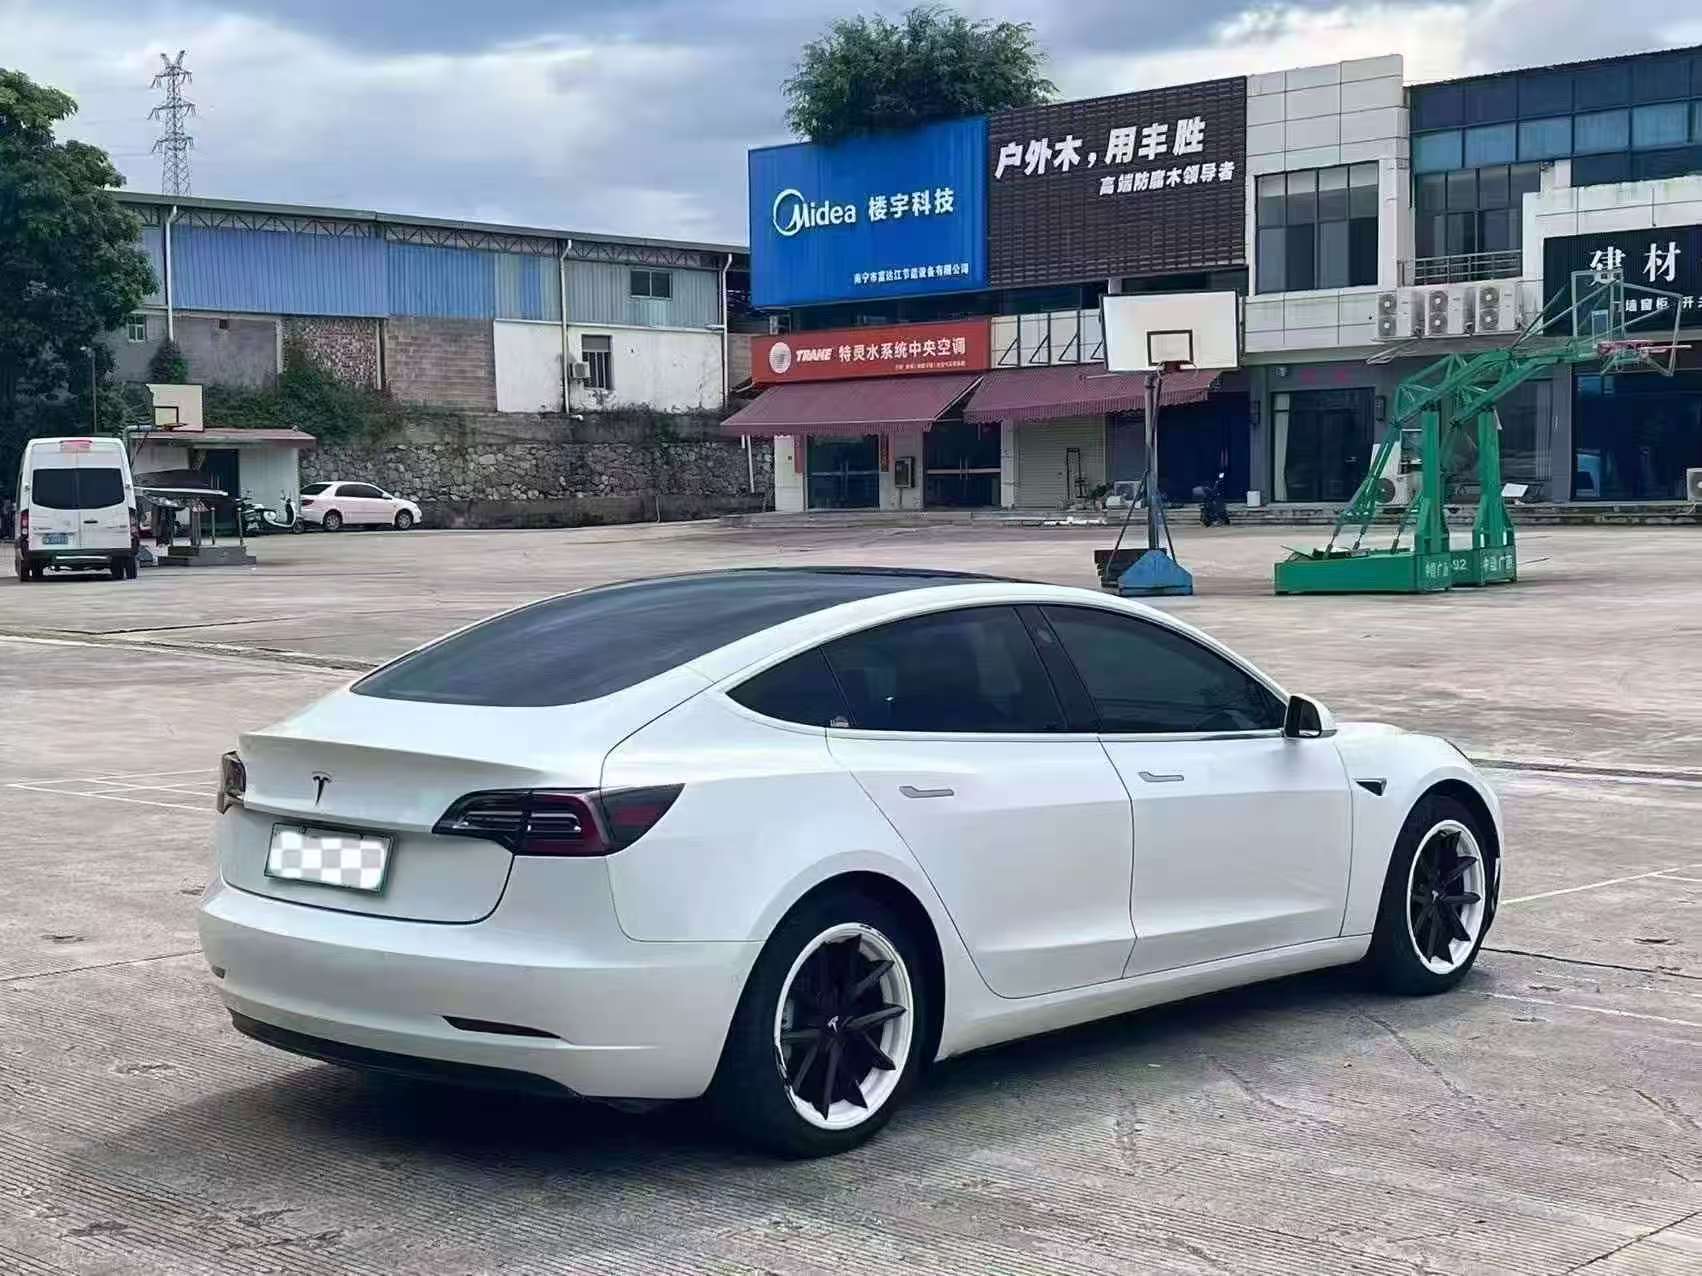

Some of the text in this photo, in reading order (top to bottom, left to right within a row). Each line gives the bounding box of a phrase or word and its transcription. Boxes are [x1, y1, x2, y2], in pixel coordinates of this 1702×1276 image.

[1099, 161, 1235, 196] 高端防腐木领导者
[773, 187, 955, 236] Midea 楼宇科技
[1588, 242, 1681, 287] 建材
[838, 337, 967, 363] 特灵水系统中央空调
